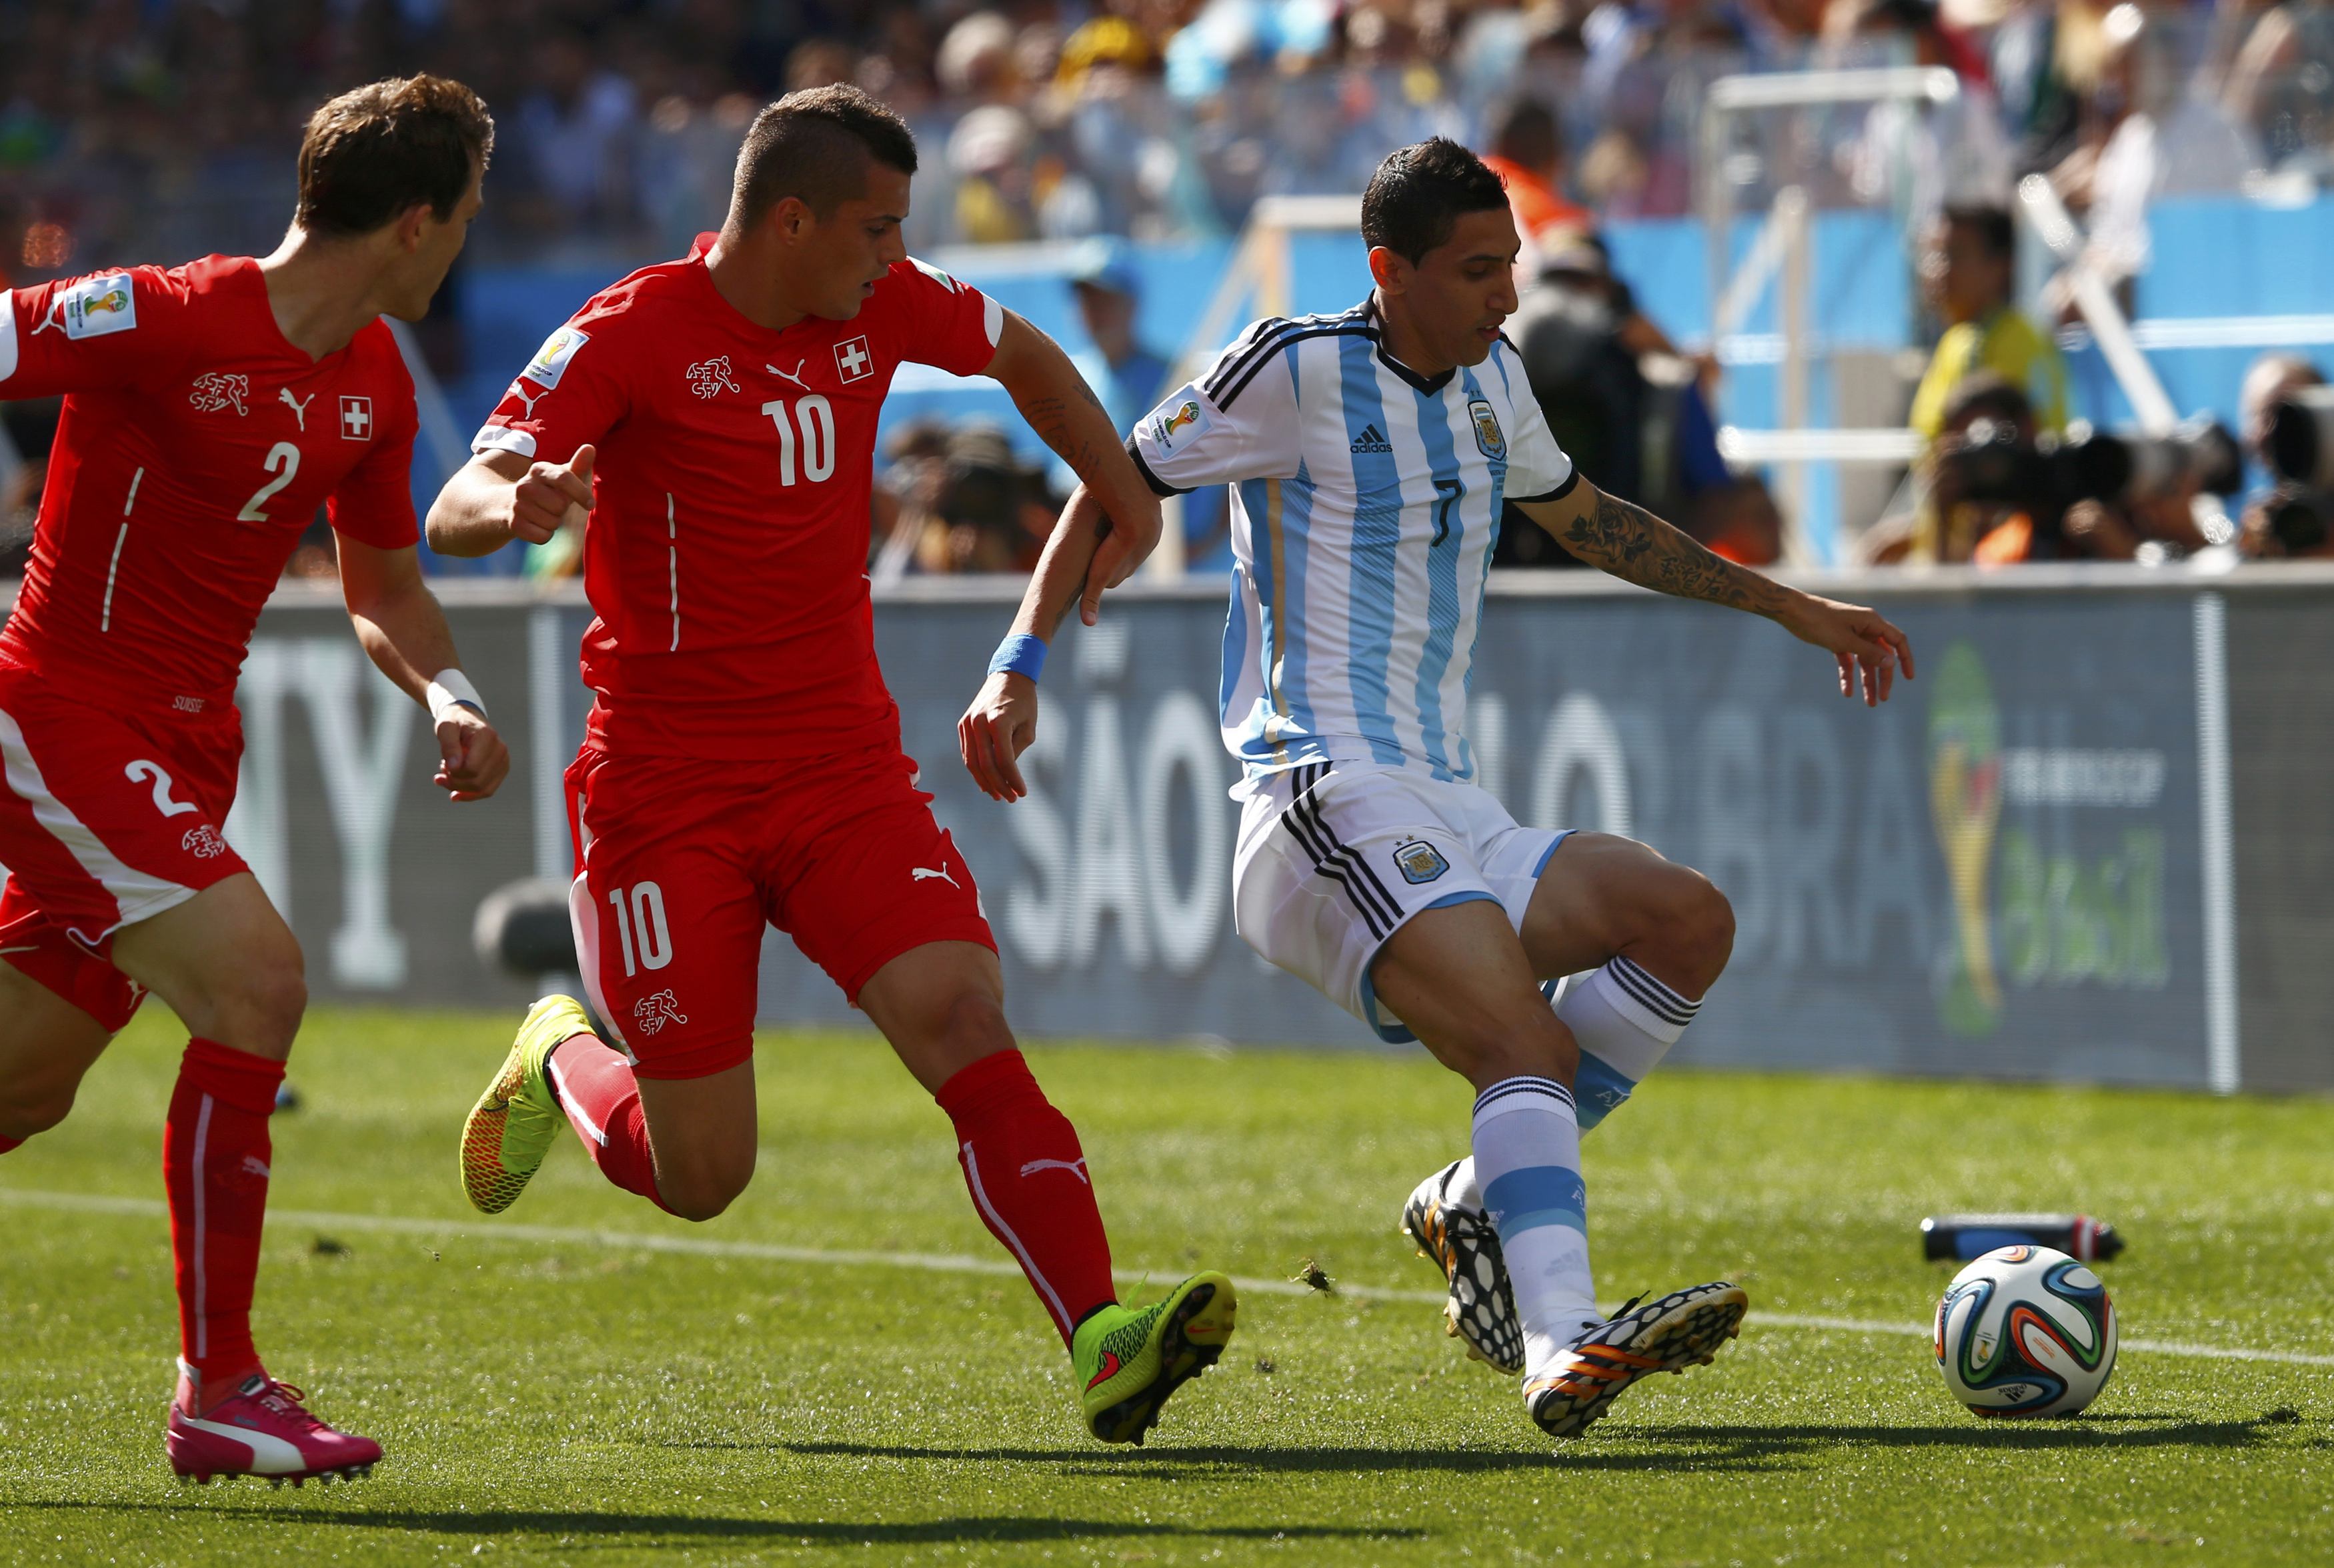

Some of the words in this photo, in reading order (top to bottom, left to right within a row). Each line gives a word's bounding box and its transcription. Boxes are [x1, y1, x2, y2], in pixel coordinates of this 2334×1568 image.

[762, 394, 835, 487] 10
[1158, 424, 1167, 439] WORLD
[1350, 442, 1393, 454] adidas
[237, 441, 301, 522] 2
[1431, 479, 1462, 547] 7
[125, 759, 199, 817] 2
[1006, 615, 1228, 973] SÃO
[610, 881, 672, 977] 10
